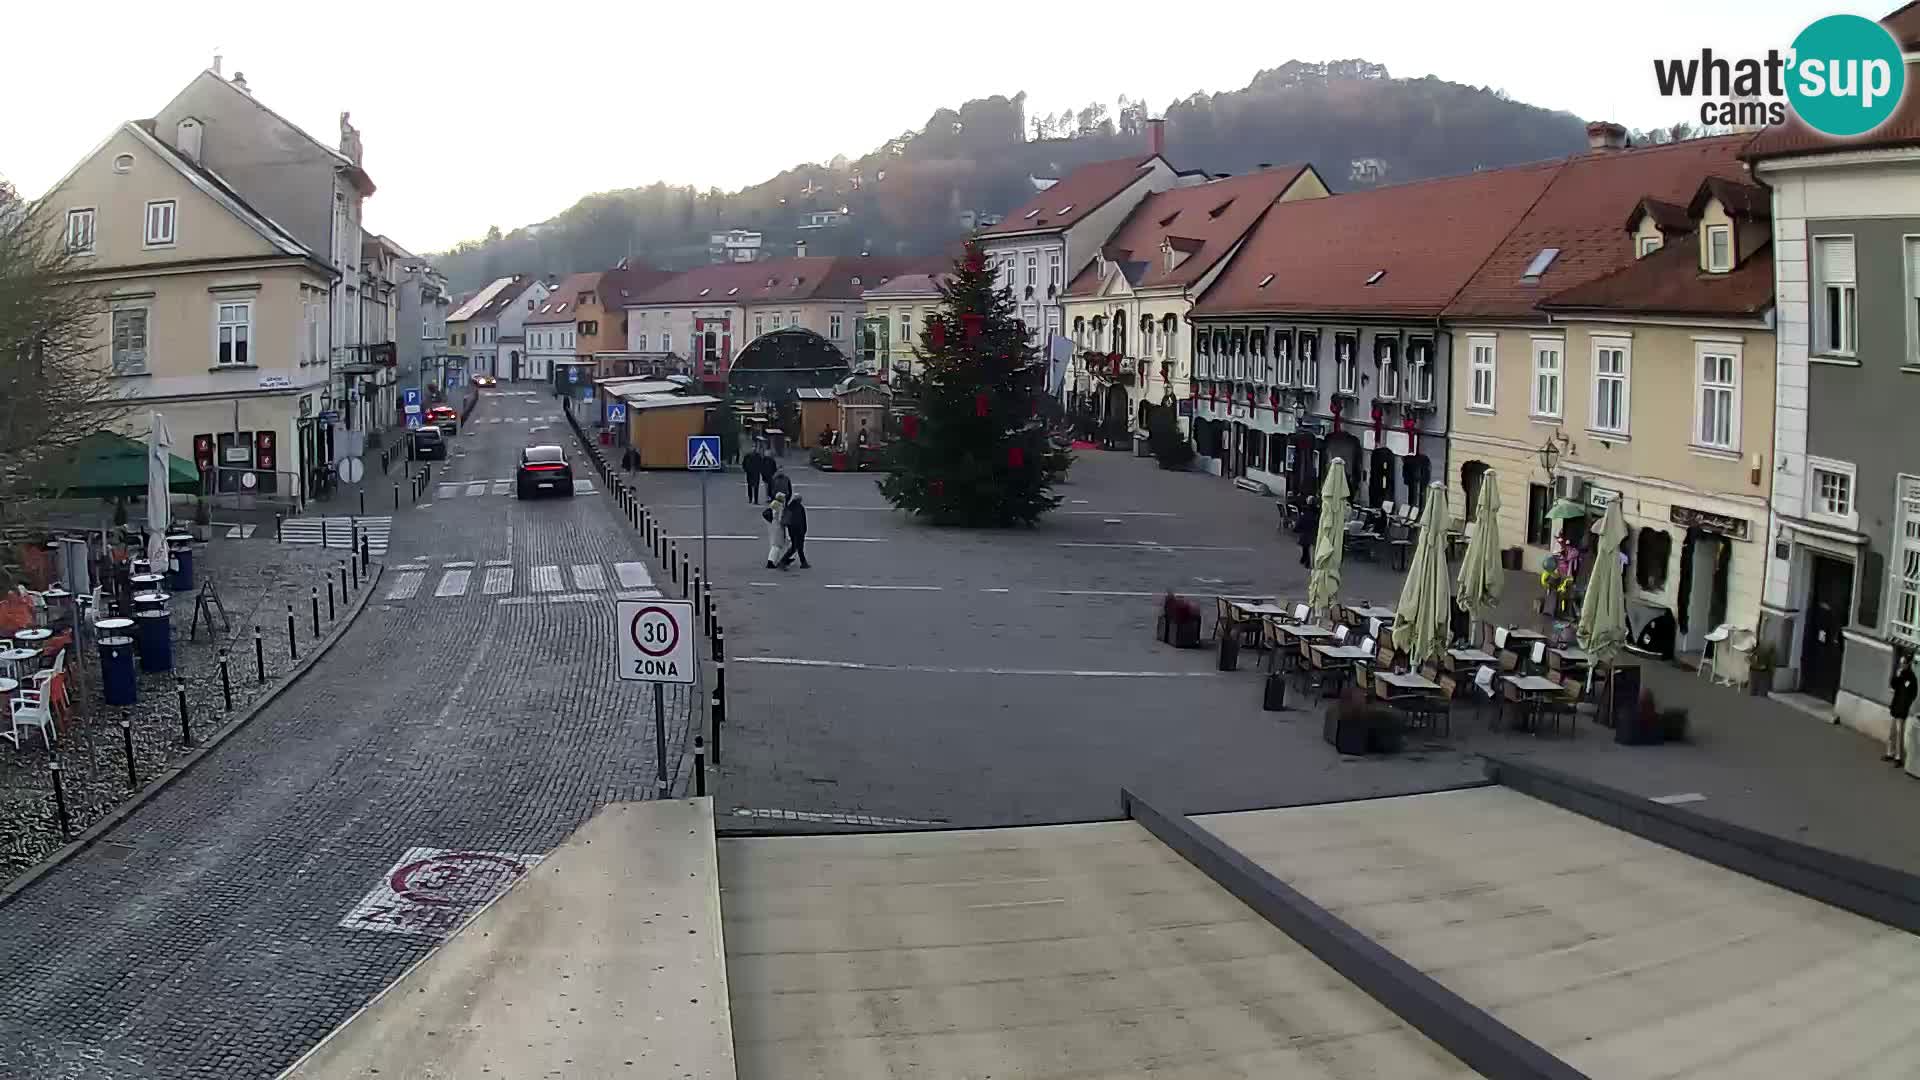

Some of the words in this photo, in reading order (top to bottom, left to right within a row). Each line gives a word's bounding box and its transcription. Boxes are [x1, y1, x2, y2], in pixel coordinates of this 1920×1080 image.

[408, 391, 417, 403] P
[644, 623, 667, 643] 30
[635, 661, 678, 676] ZONA
